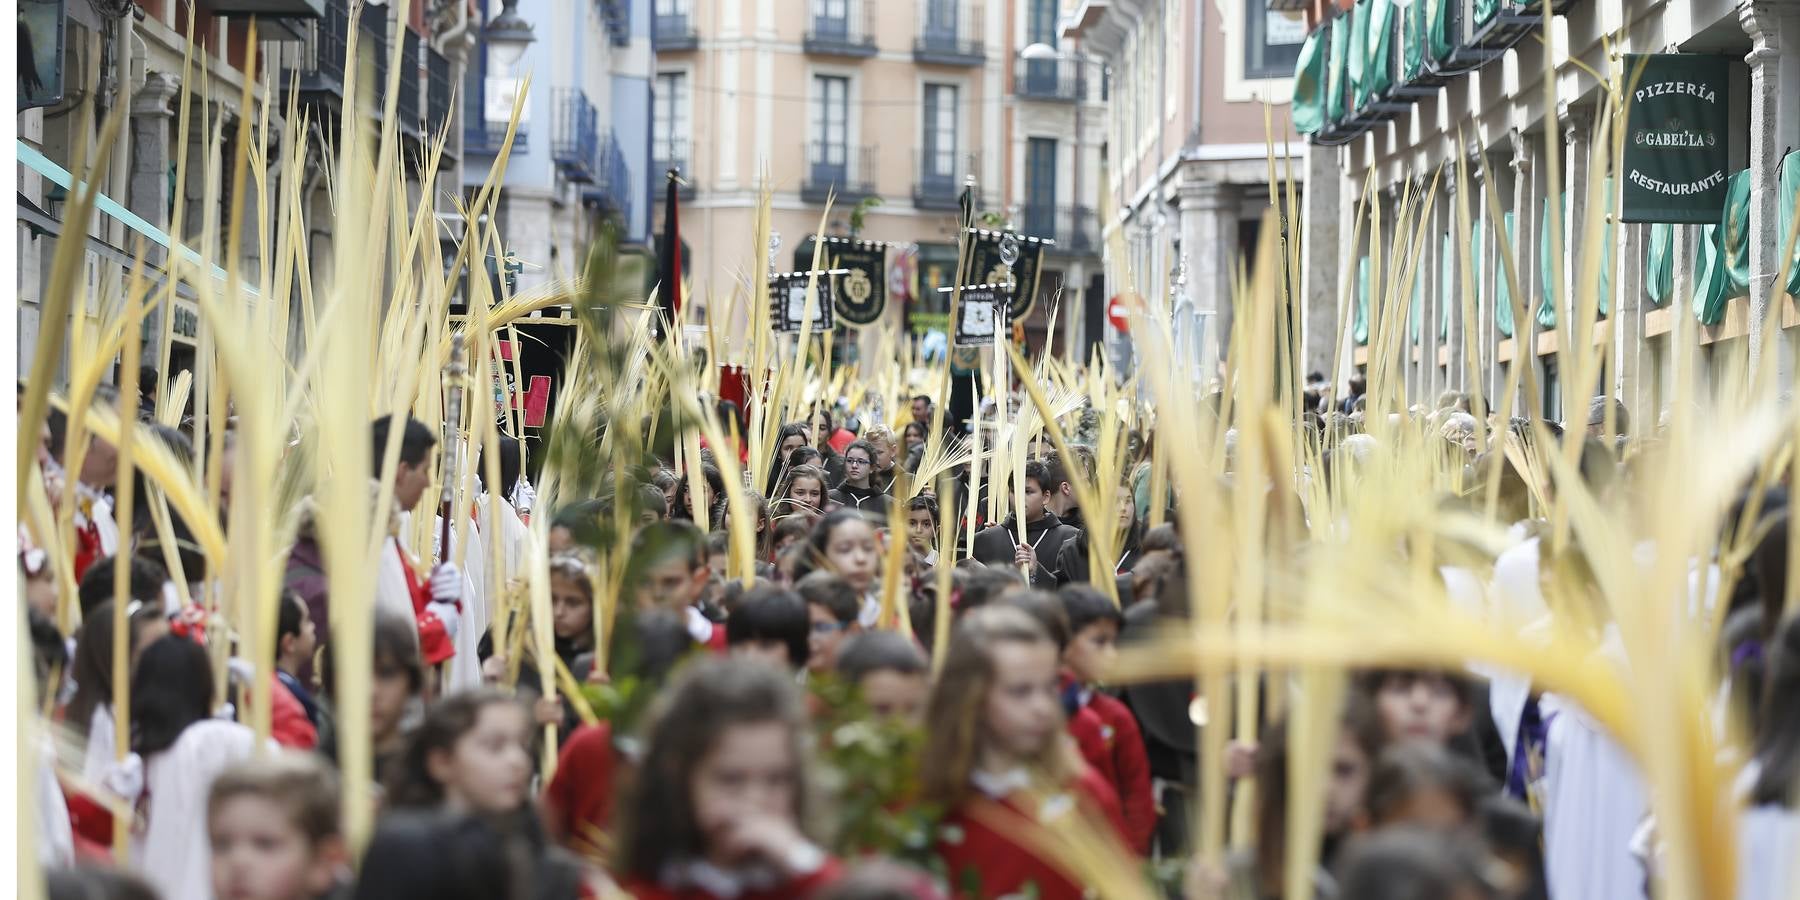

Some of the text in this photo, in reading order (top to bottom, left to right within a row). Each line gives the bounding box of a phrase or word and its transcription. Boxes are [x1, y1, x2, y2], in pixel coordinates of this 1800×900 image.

[1635, 82, 1715, 104] PIZZERÍA
[1646, 130, 1704, 147] GABEL'LA
[1629, 169, 1725, 195] RESTAURANTE
